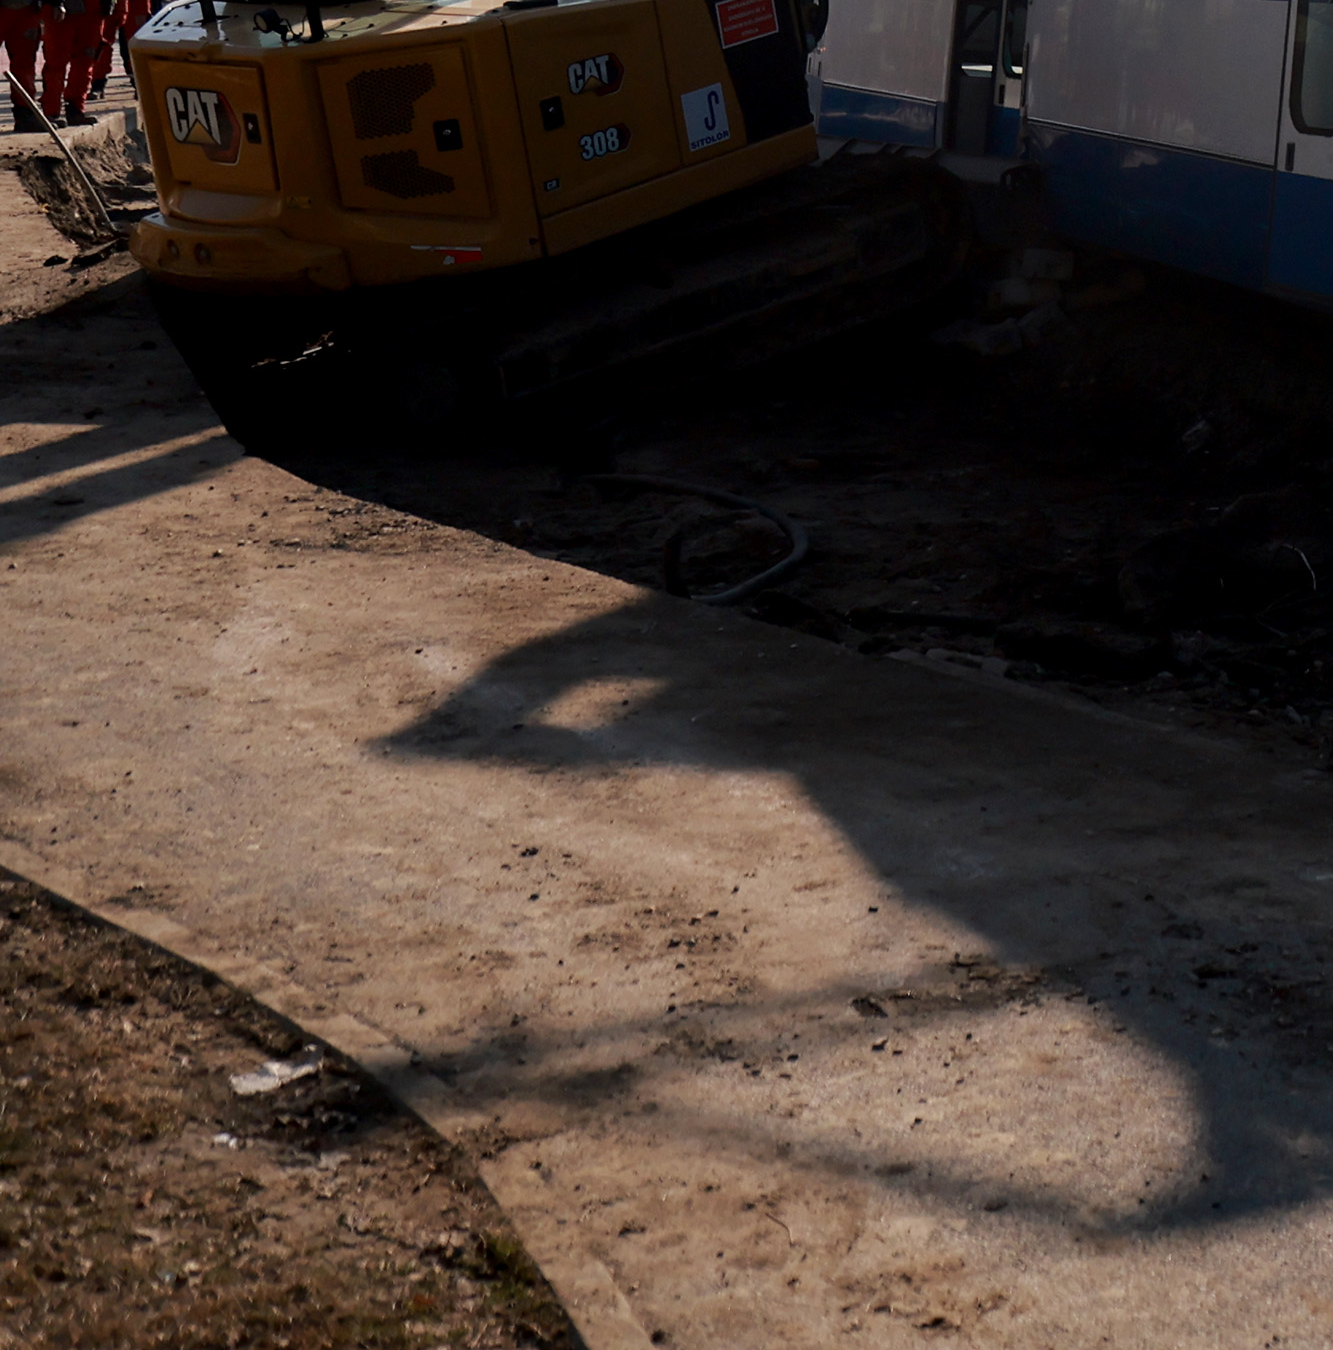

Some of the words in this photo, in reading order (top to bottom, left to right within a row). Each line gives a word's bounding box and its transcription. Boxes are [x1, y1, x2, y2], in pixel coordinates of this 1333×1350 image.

[568, 54, 611, 95] CAT
[165, 87, 222, 146] CAT
[579, 126, 621, 161] 308
[691, 130, 729, 149] SITOLOR
